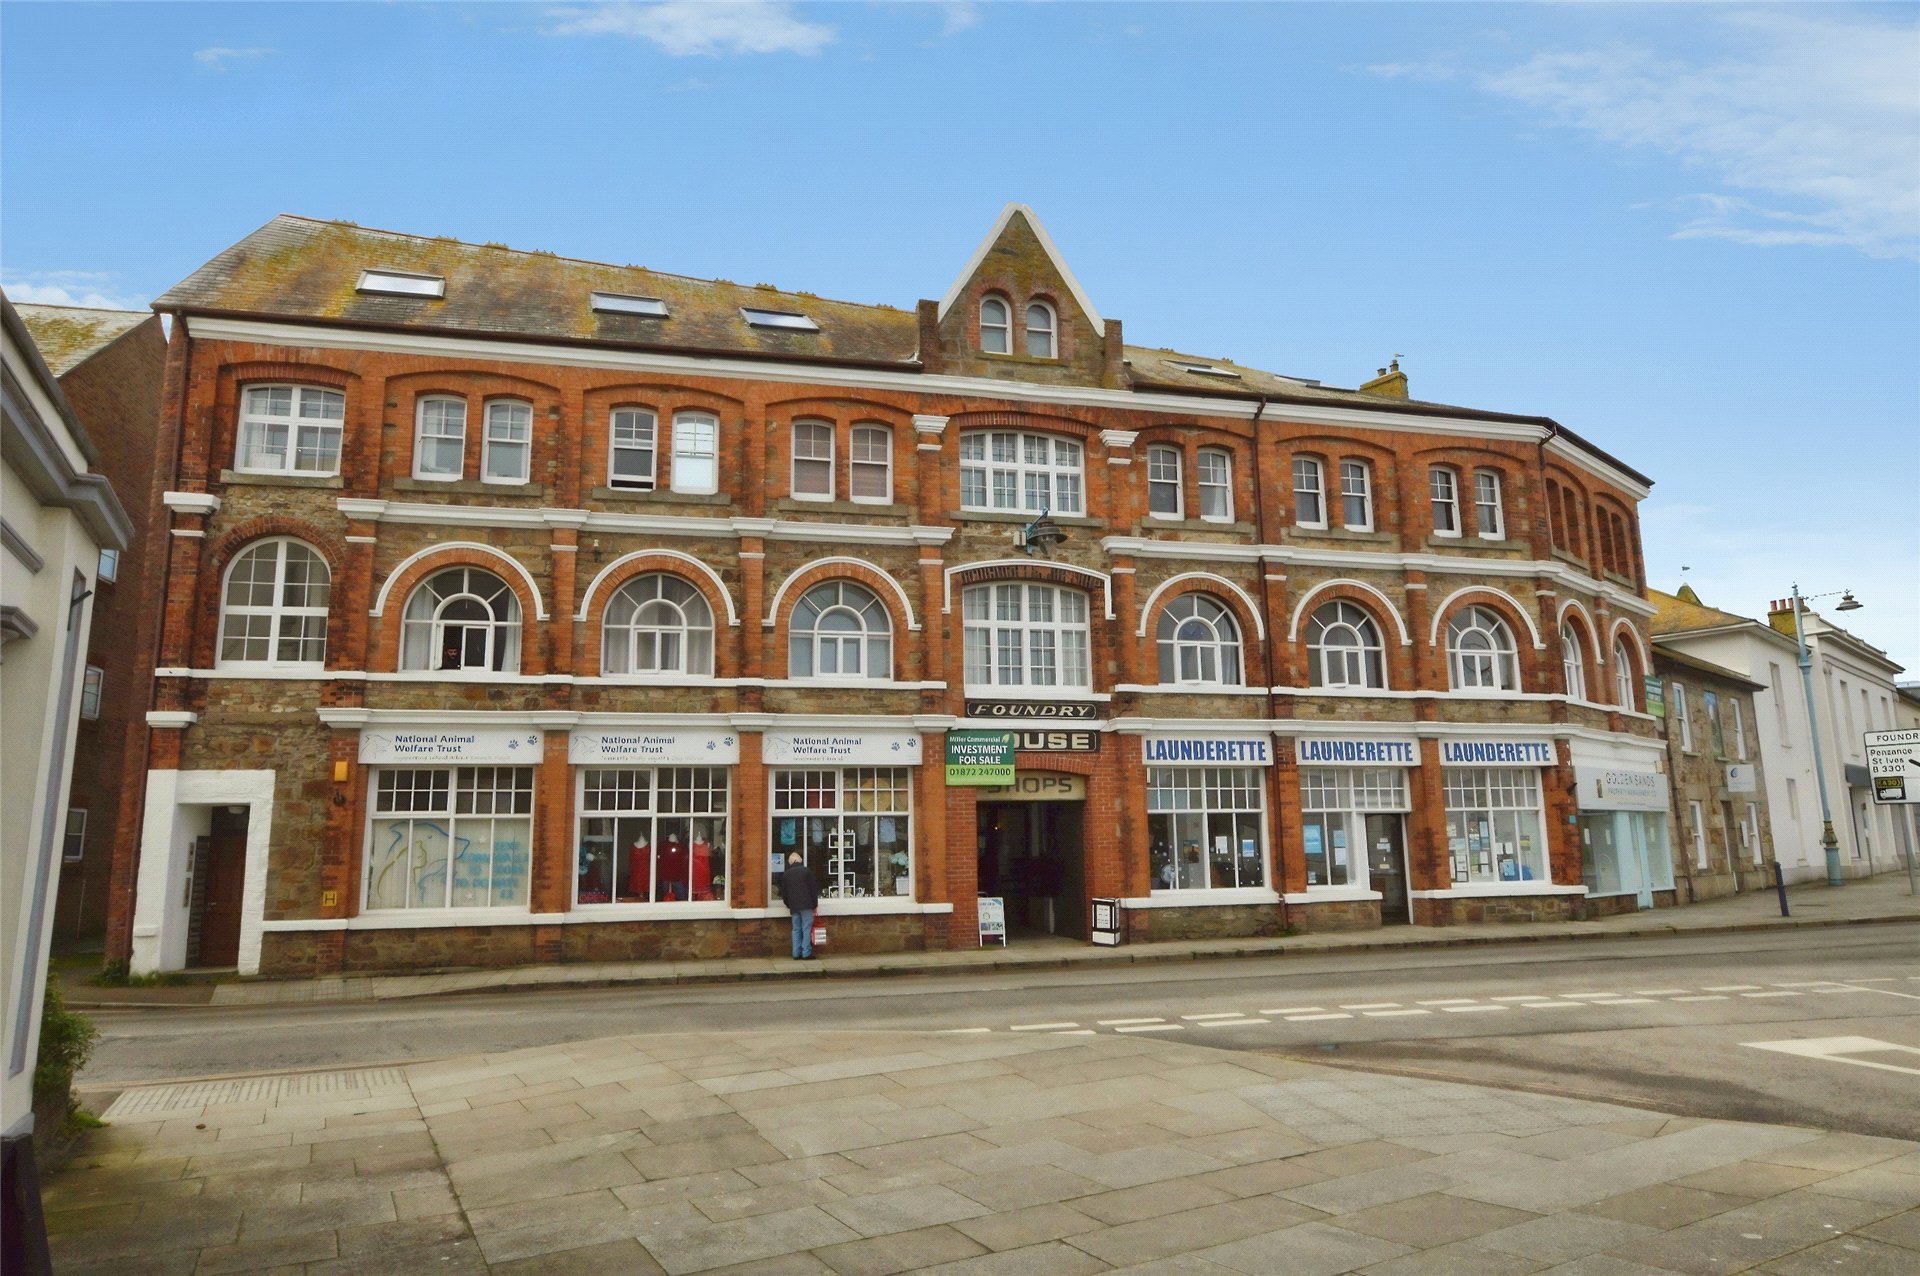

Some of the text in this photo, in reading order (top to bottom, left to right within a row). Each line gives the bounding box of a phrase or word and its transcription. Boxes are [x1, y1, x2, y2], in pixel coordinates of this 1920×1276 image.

[974, 704, 1090, 717] FOUNDRY
[394, 735, 475, 743] National Animal
[601, 736, 675, 744] National Animal
[793, 737, 862, 745] National Animal
[1013, 732, 1090, 749] USE
[394, 744, 462, 752] Welfare Trust
[601, 745, 663, 753] Welfare Trust
[951, 745, 1008, 754] INVESTMENT
[1145, 739, 1267, 761] LAUNDERETTE
[1300, 740, 1413, 762] LAUNDERETTE
[1443, 742, 1551, 762] LAUNDERETTE
[1870, 748, 1913, 756] Penzance
[958, 756, 1001, 765] FOR SALE
[1872, 757, 1883, 765] St
[949, 768, 1011, 776] 01872 247000
[1873, 764, 1905, 773] B 3301
[325, 893, 336, 905] H
